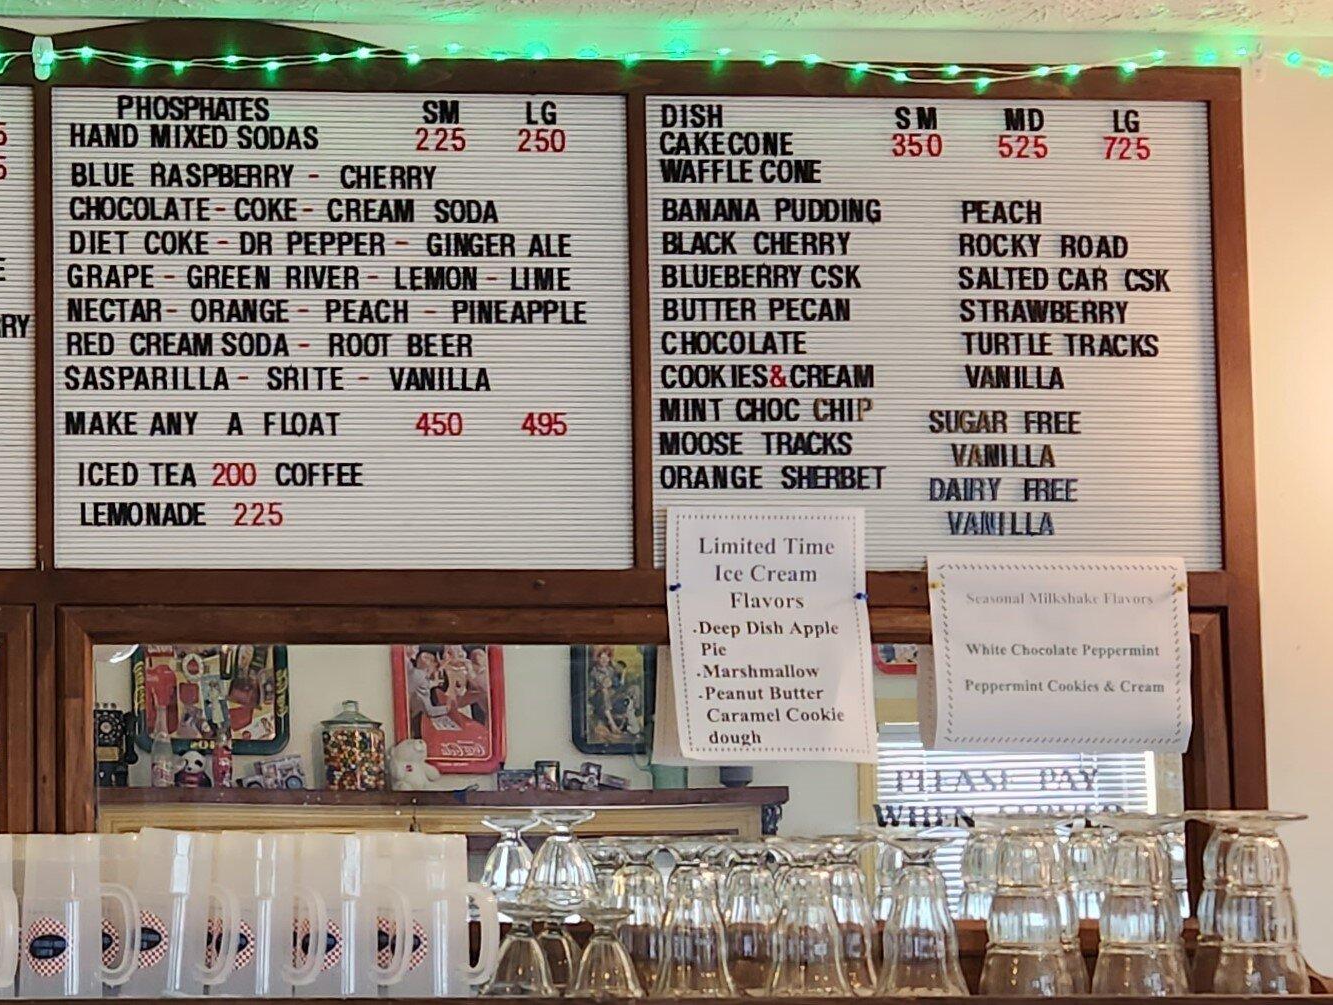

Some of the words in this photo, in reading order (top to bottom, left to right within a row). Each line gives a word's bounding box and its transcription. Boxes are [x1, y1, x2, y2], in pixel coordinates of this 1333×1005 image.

[118, 96, 269, 121] PHOSPHATES
[423, 96, 459, 121] SM
[527, 96, 557, 121] LG
[661, 104, 723, 129] DISH
[895, 107, 938, 132] SM
[1005, 107, 1044, 132] MD
[1114, 107, 1139, 132] LG
[70, 124, 138, 149] HAND
[151, 124, 227, 149] MIXED
[238, 124, 318, 149] SODAS
[416, 129, 465, 153] 225
[518, 129, 566, 153] 250
[892, 134, 942, 160] 350
[999, 134, 1048, 160] 525
[1104, 134, 1150, 160] 725
[72, 164, 134, 189] BLUE
[151, 164, 294, 189] RASPBERRY
[341, 164, 436, 189] CHERRY
[660, 159, 753, 184] WAFFLE
[760, 159, 821, 184] CONE
[663, 198, 760, 224] BANANA
[775, 198, 881, 224] PUDDING
[963, 200, 1042, 225] PEACH
[663, 232, 737, 257] BLACK
[754, 232, 850, 257] CHERRY
[961, 233, 1040, 259] ROCKY
[1061, 233, 1127, 259] ROAD
[663, 298, 756, 322] BUTTER
[770, 298, 849, 322] PECAN
[960, 300, 1128, 325] STRAWBERRY
[662, 330, 806, 356] CHOCOLATE
[966, 332, 1052, 358] TURTLE
[1066, 332, 1159, 358] TRACKS
[966, 365, 1064, 390] VANILLA
[660, 398, 722, 423] MINT
[736, 398, 800, 423] CHOC
[813, 398, 873, 423] CHIP
[929, 410, 1007, 435] SUGAR
[1025, 410, 1081, 435] FREE
[65, 412, 137, 436] MAKE
[150, 412, 197, 436] ANY
[228, 412, 243, 436] A
[264, 412, 340, 436] FLOAT
[416, 412, 463, 436] 450
[522, 412, 567, 436] 495
[952, 443, 1055, 468] VANILLA
[79, 462, 138, 487] ICED
[149, 462, 196, 487] TEA
[212, 462, 256, 487] 200
[276, 462, 364, 487] COFFEE
[660, 465, 763, 490] ORANGE
[781, 465, 886, 490] SHERBET
[929, 478, 1001, 502] DAIRY
[1024, 478, 1079, 502] FREE
[81, 502, 206, 526] LEMONADE
[234, 502, 283, 526] 225
[947, 511, 1055, 536] VANILLA
[698, 537, 778, 556] Limited
[783, 537, 835, 556] Time
[715, 564, 745, 583] Ice
[751, 564, 818, 583] Cream
[730, 591, 805, 610] Flavors
[966, 592, 1024, 606] Seasonal
[1031, 592, 1098, 606] Milkshake
[1103, 592, 1154, 606] Flavors
[699, 621, 740, 639] Deep
[746, 621, 784, 639] Dish
[790, 621, 839, 639] Apple
[701, 641, 727, 658] Pie
[967, 642, 1007, 659] White
[1012, 642, 1077, 659] Chocolate
[1082, 642, 1159, 659] Peppermint
[703, 663, 819, 679] Marshmallow
[706, 685, 763, 701] Peanut
[770, 685, 824, 701] Butter
[966, 679, 1042, 695] Peppermint
[1047, 679, 1099, 695] Cookies
[1103, 679, 1115, 695] &
[1120, 679, 1165, 695] Cream
[707, 707, 780, 724] Caramel
[786, 707, 845, 724] Cookie
[709, 728, 761, 747] dough
